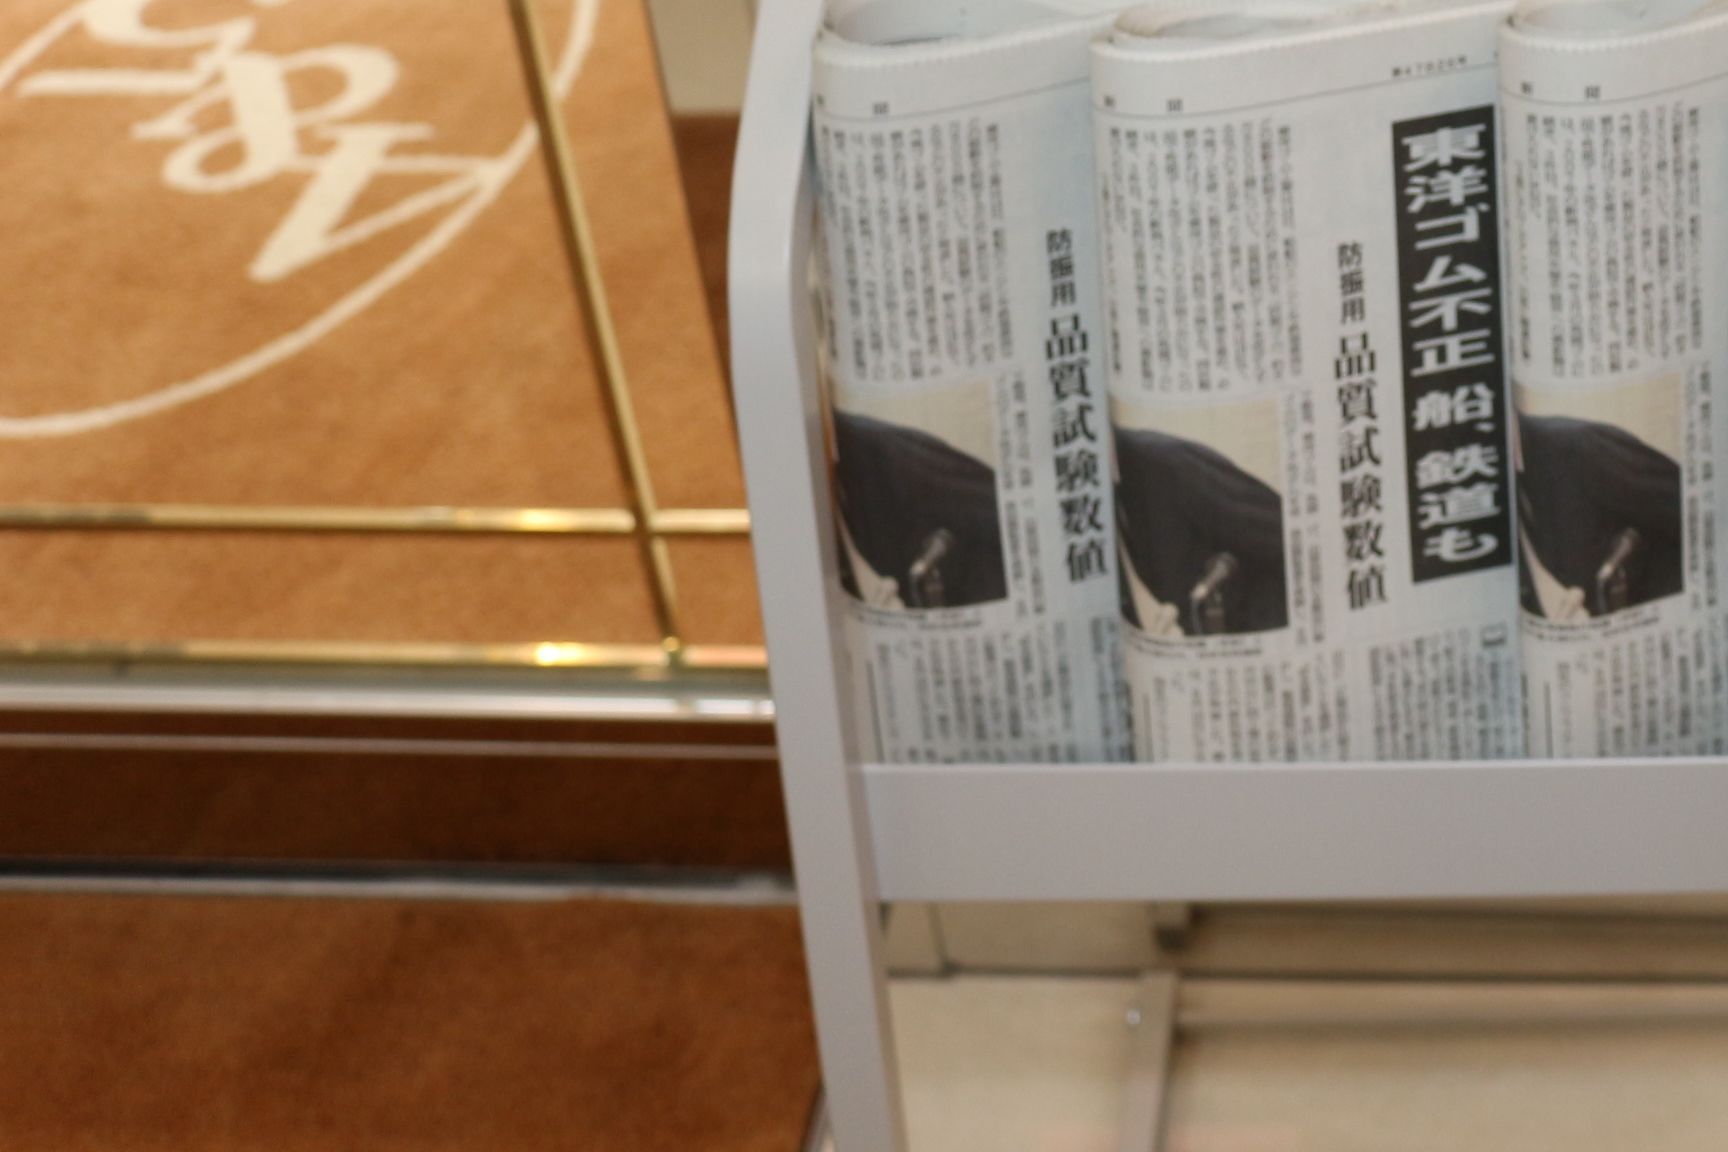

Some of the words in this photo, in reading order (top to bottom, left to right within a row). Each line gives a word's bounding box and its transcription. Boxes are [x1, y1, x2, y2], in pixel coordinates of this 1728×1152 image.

[1402, 123, 1496, 377] 東洋ゴム不正
[1045, 313, 1107, 583] 品質試験数値
[1334, 331, 1390, 611] 品質試験数値
[1412, 382, 1500, 561] 船、鉄道も
